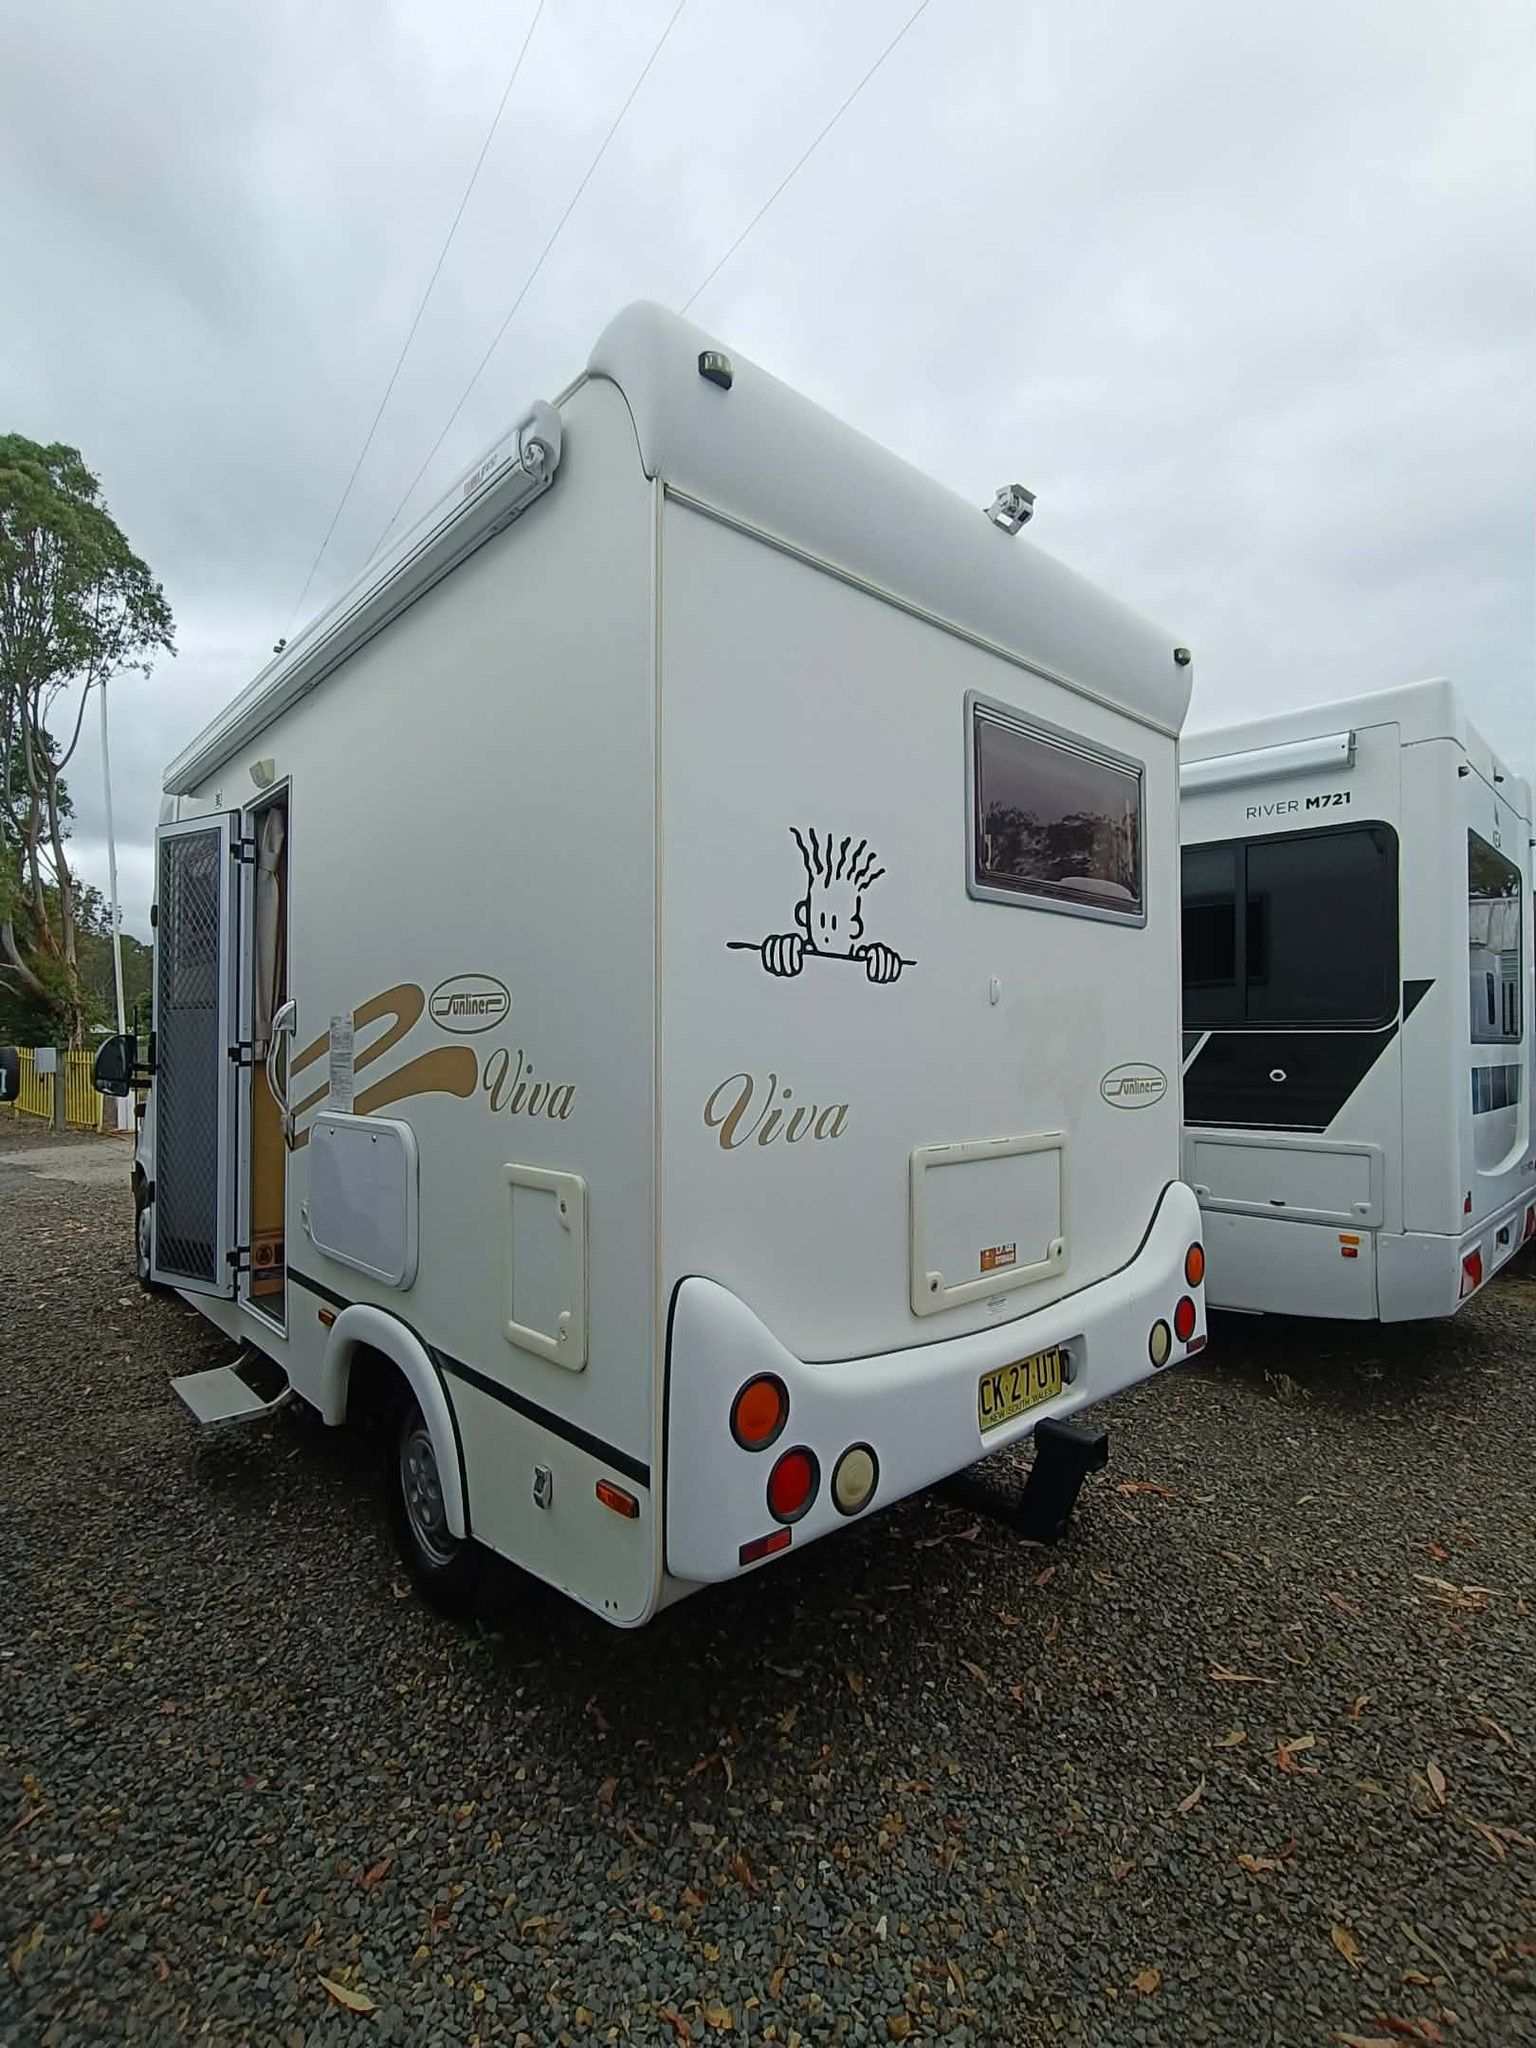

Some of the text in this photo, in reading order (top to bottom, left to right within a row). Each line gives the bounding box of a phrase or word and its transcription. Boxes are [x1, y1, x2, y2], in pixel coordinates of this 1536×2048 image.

[1246, 791, 1351, 820] RIVER M721
[433, 993, 505, 1016] Sunliner
[483, 1048, 576, 1119] Viva
[1105, 1077, 1163, 1096] Sunliner
[704, 1073, 849, 1149] Viva
